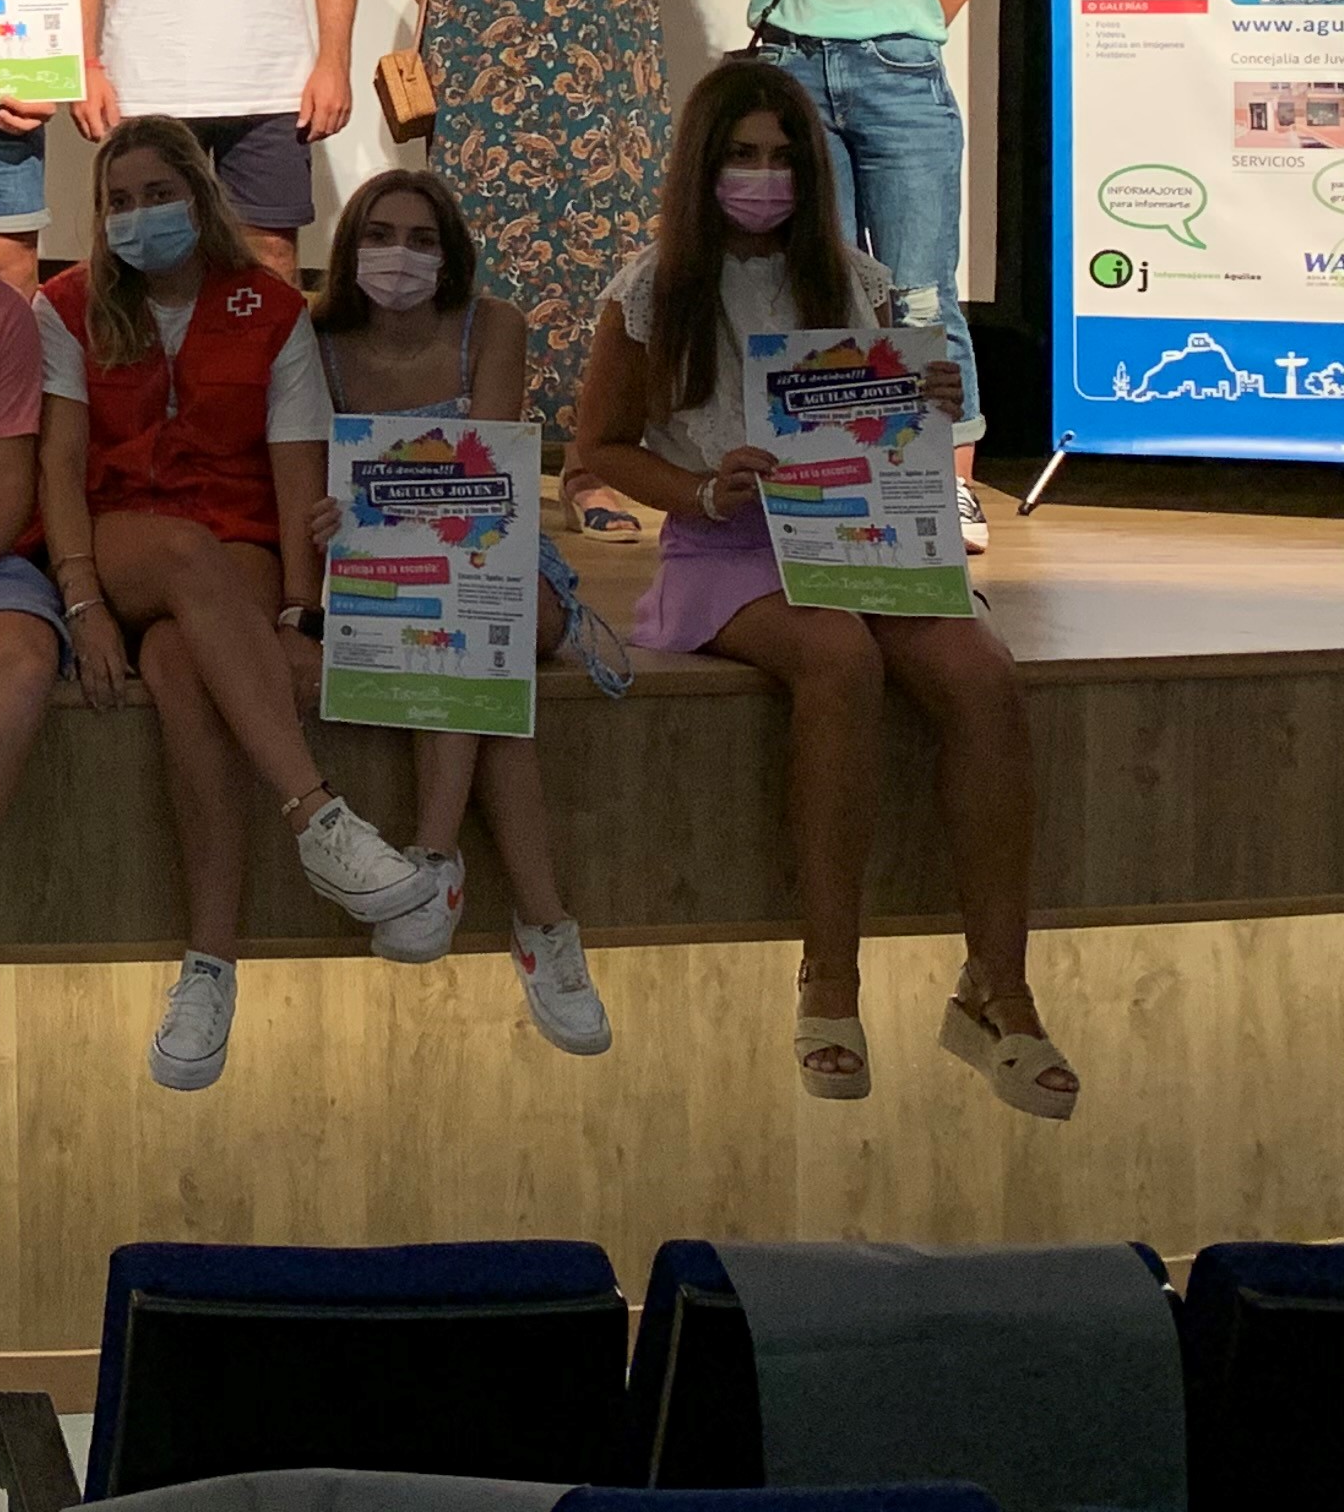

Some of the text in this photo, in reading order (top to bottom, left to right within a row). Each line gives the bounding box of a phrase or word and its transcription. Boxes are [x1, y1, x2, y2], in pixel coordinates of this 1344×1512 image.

[1232, 19, 1344, 37] www.agu
[1304, 53, 1320, 64] de
[1324, 53, 1344, 64] Juv
[1231, 155, 1306, 168] SERVICIOS
[1107, 187, 1193, 196] INFORMAJOVEN
[1135, 199, 1190, 208] informarte
[1304, 252, 1344, 273] WA
[387, 483, 493, 500] ÁGUILAS JOVEN
